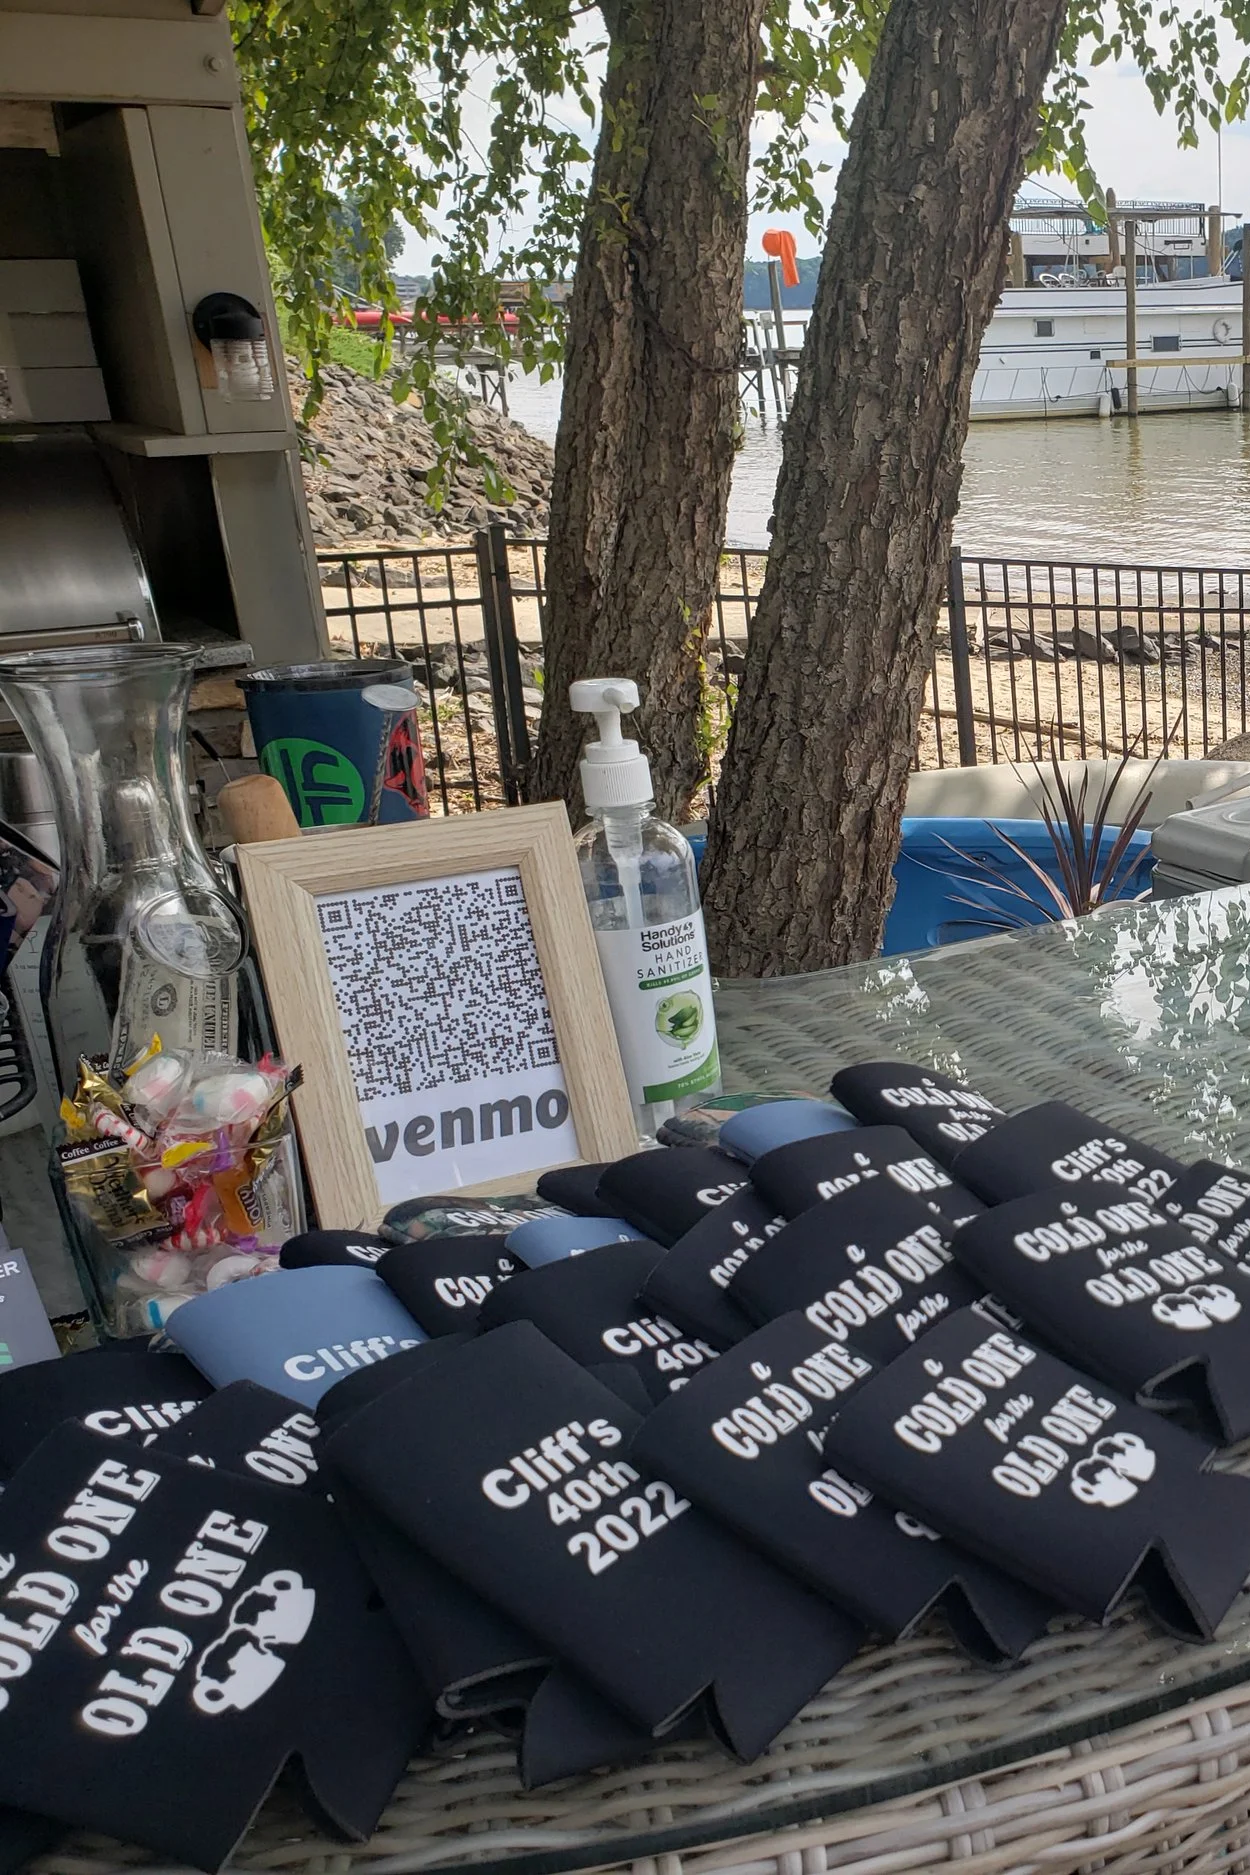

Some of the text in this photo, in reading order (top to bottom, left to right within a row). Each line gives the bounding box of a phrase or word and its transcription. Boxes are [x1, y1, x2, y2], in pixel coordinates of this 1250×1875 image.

[640, 925, 683, 943] Handy
[641, 930, 695, 953] Solutions
[637, 951, 704, 980] SANITIZER
[655, 945, 692, 965] HAND
[881, 1086, 957, 1108] COLD
[364, 1088, 571, 1164] venmo
[61, 1138, 120, 1160] Coffee Coffee
[853, 1152, 871, 1167] a
[1051, 1137, 1127, 1183] Cliff's
[886, 1157, 954, 1194] ONE
[732, 1220, 749, 1237] a
[1059, 1200, 1079, 1216] a
[1165, 1201, 1183, 1216] a
[1013, 1200, 1168, 1263] COLD ONE
[1217, 1233, 1245, 1258] for
[498, 1258, 515, 1272] a
[846, 1244, 866, 1264] a
[1096, 1238, 1149, 1269] for the
[805, 1264, 903, 1342] COLD
[884, 1225, 953, 1284] ONE
[1085, 1245, 1224, 1307] OLD ONE
[895, 1310, 928, 1342] for
[918, 1292, 950, 1321] the
[283, 1335, 424, 1382] Cliff's
[751, 1361, 772, 1382] a
[923, 1358, 944, 1377] a
[711, 1382, 813, 1460] COLD
[791, 1342, 873, 1401] ONE
[893, 1375, 987, 1453] COLD
[961, 1332, 1037, 1389] ONE
[984, 1393, 1034, 1444] for the
[992, 1383, 1117, 1498] OLD ONE
[481, 1418, 624, 1509] Cliff's
[548, 1459, 640, 1527] 40th
[566, 1479, 692, 1576] 2022
[0, 1459, 161, 1712] OLD ONE
[73, 1558, 149, 1656] for the
[81, 1509, 269, 1736] OLD ONE
